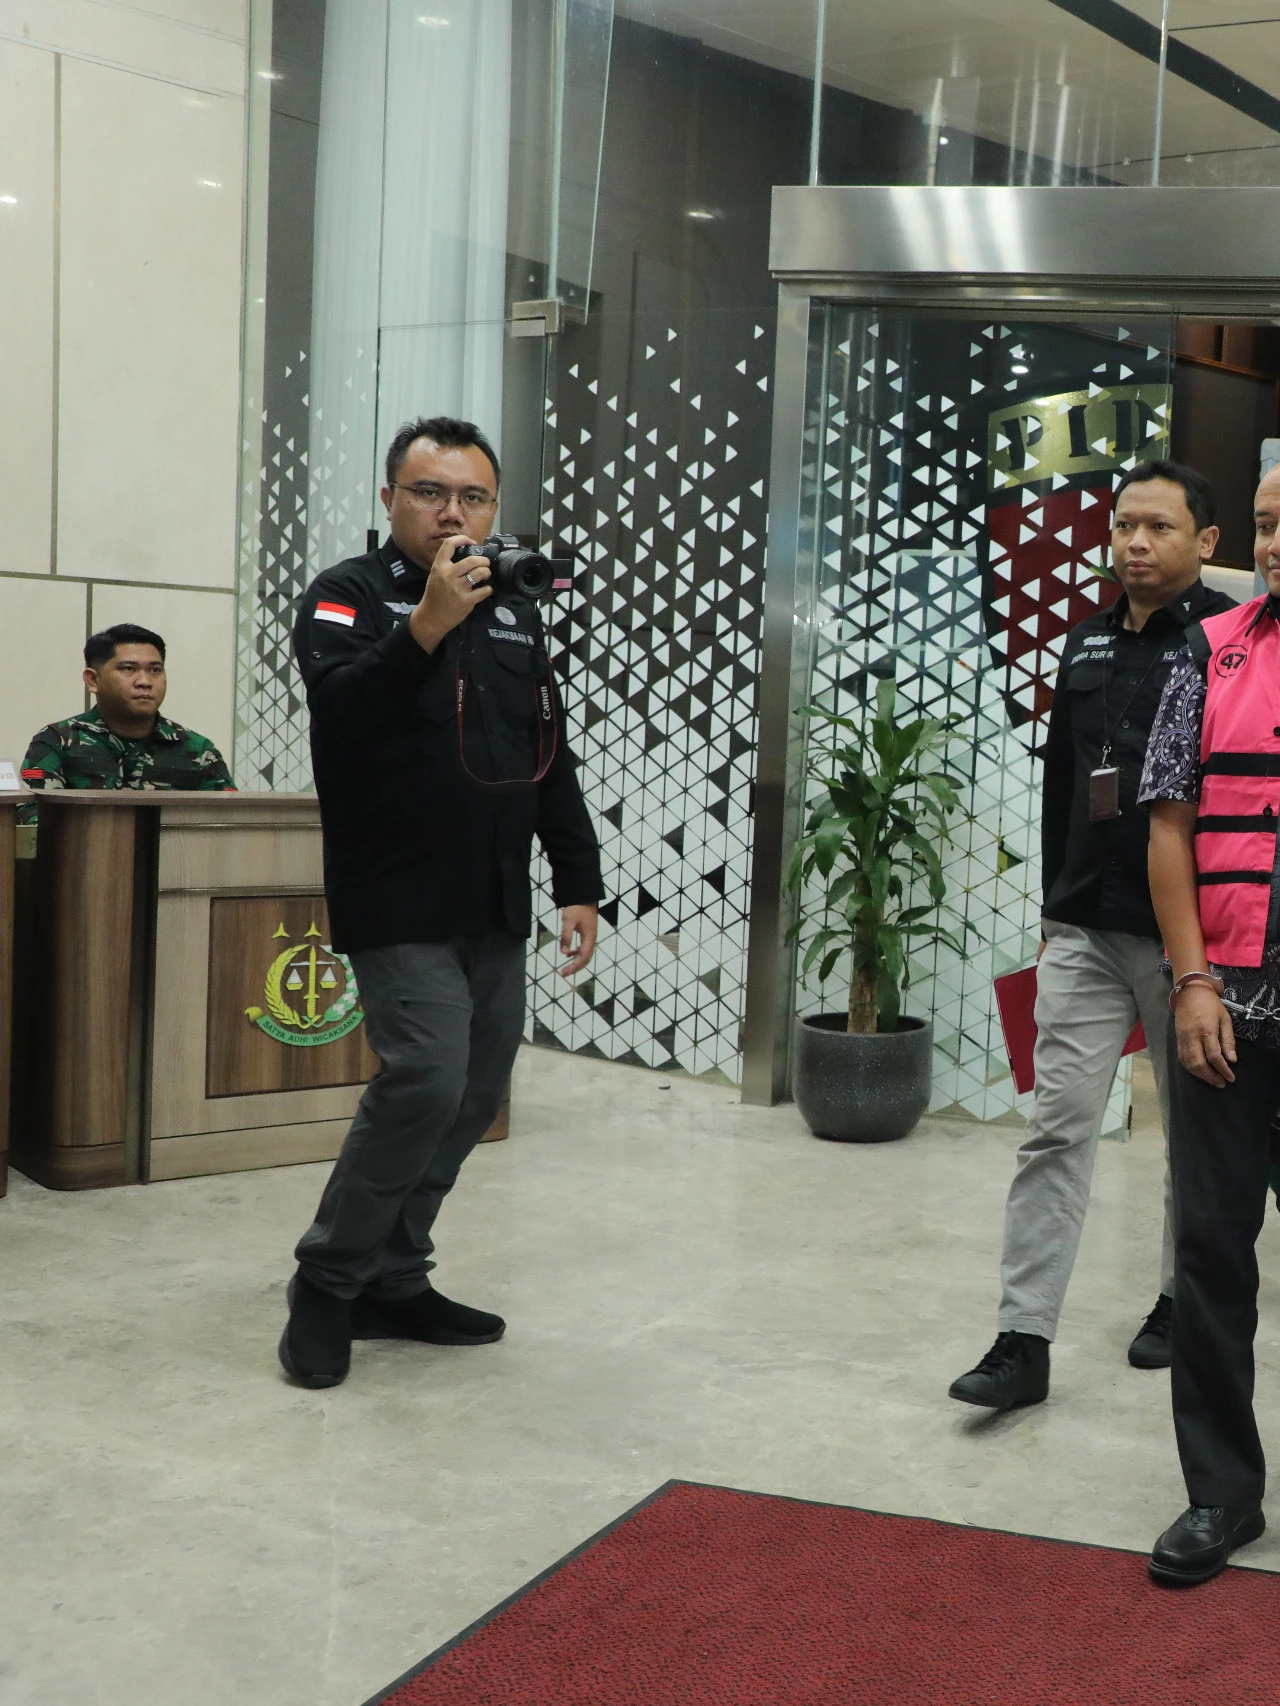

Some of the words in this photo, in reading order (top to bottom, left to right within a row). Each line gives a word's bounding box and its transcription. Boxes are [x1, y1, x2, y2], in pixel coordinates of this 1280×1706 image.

[1162, 650, 1178, 660] KEJ
[1220, 652, 1247, 670] 47
[540, 685, 552, 721] Canon
[262, 1020, 286, 1040] SATYA
[287, 1035, 308, 1043] ADHI
[312, 1015, 359, 1043] WICAKSANA
